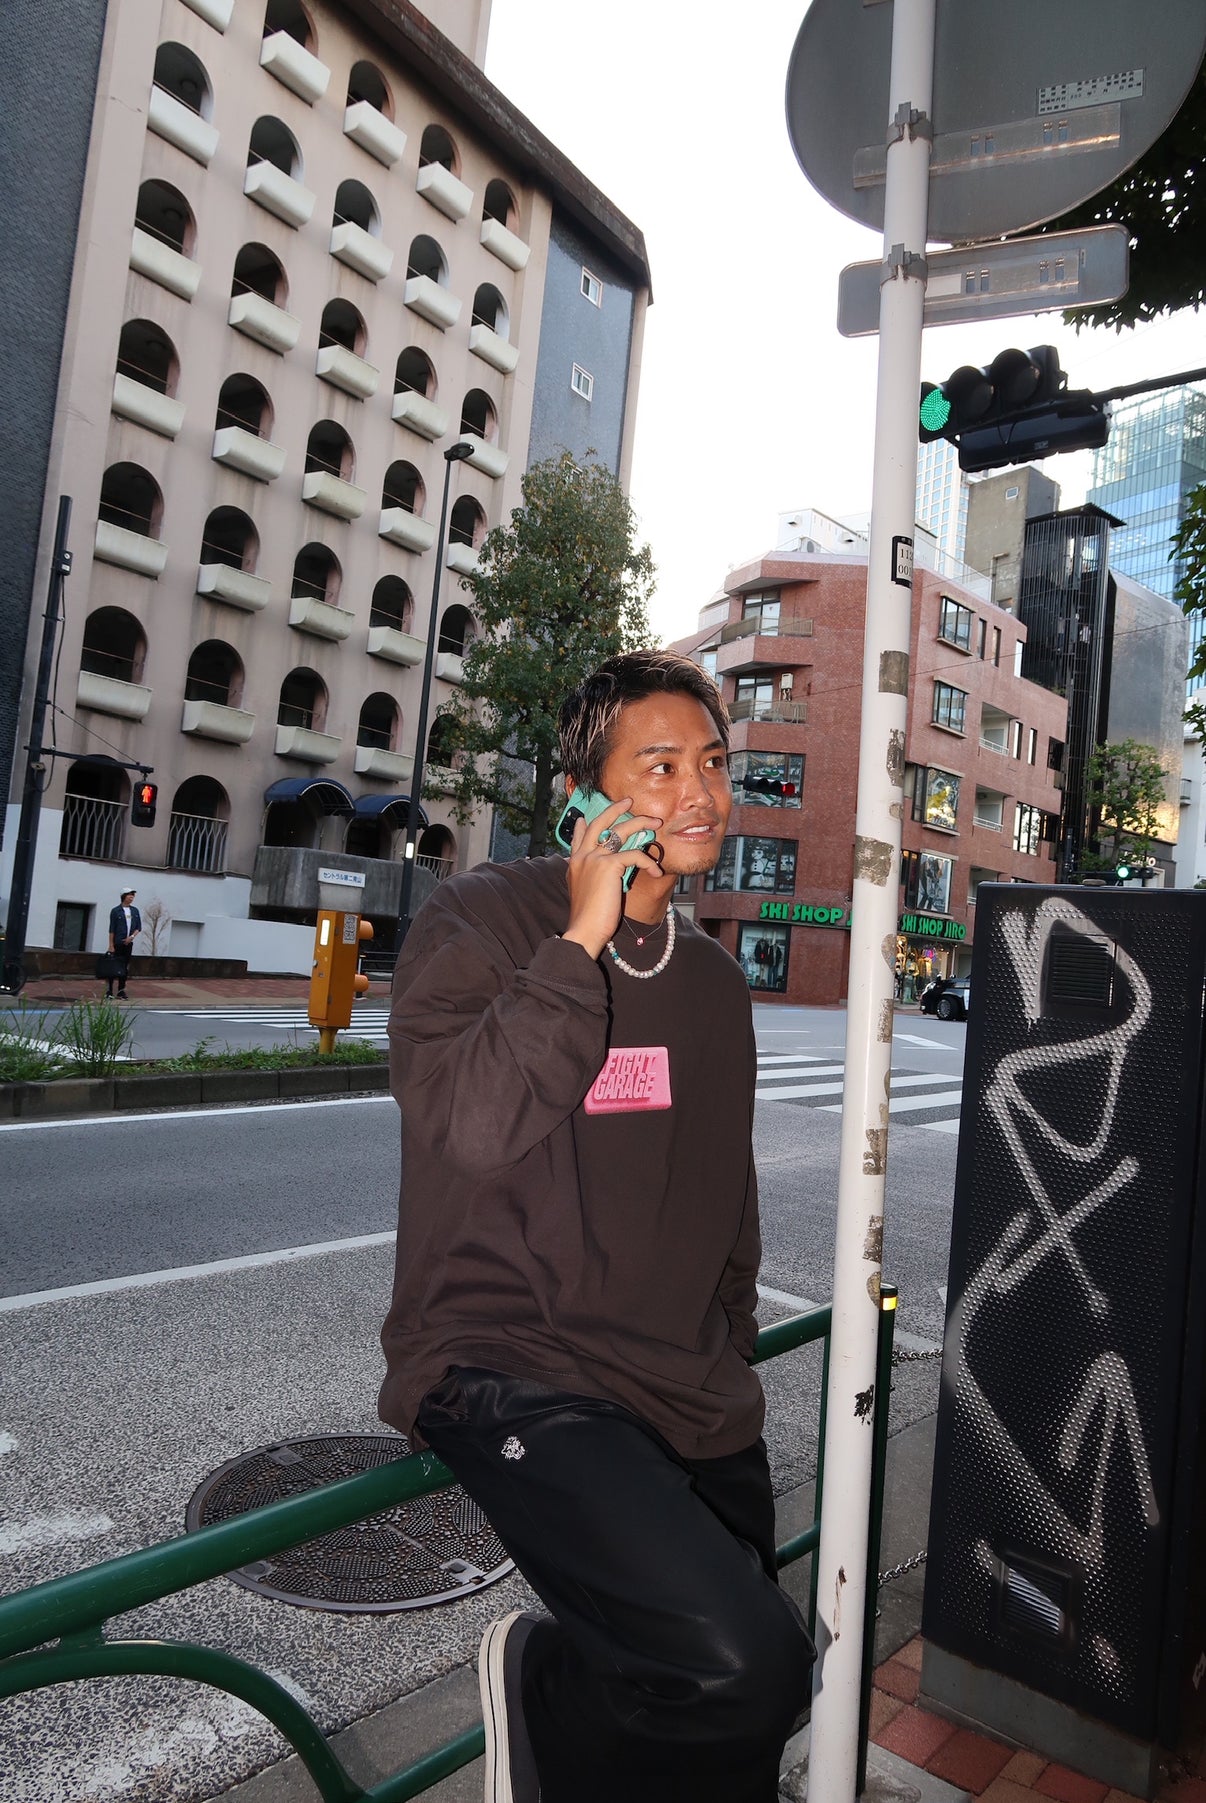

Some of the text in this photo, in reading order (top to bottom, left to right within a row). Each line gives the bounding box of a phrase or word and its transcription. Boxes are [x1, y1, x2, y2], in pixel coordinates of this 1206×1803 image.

[760, 902, 789, 920] SKI
[792, 904, 844, 924] SHOP
[901, 914, 967, 939] SKI SHOP JIRO
[605, 1052, 658, 1075] FIGHT
[594, 1071, 656, 1100] GARAGE
